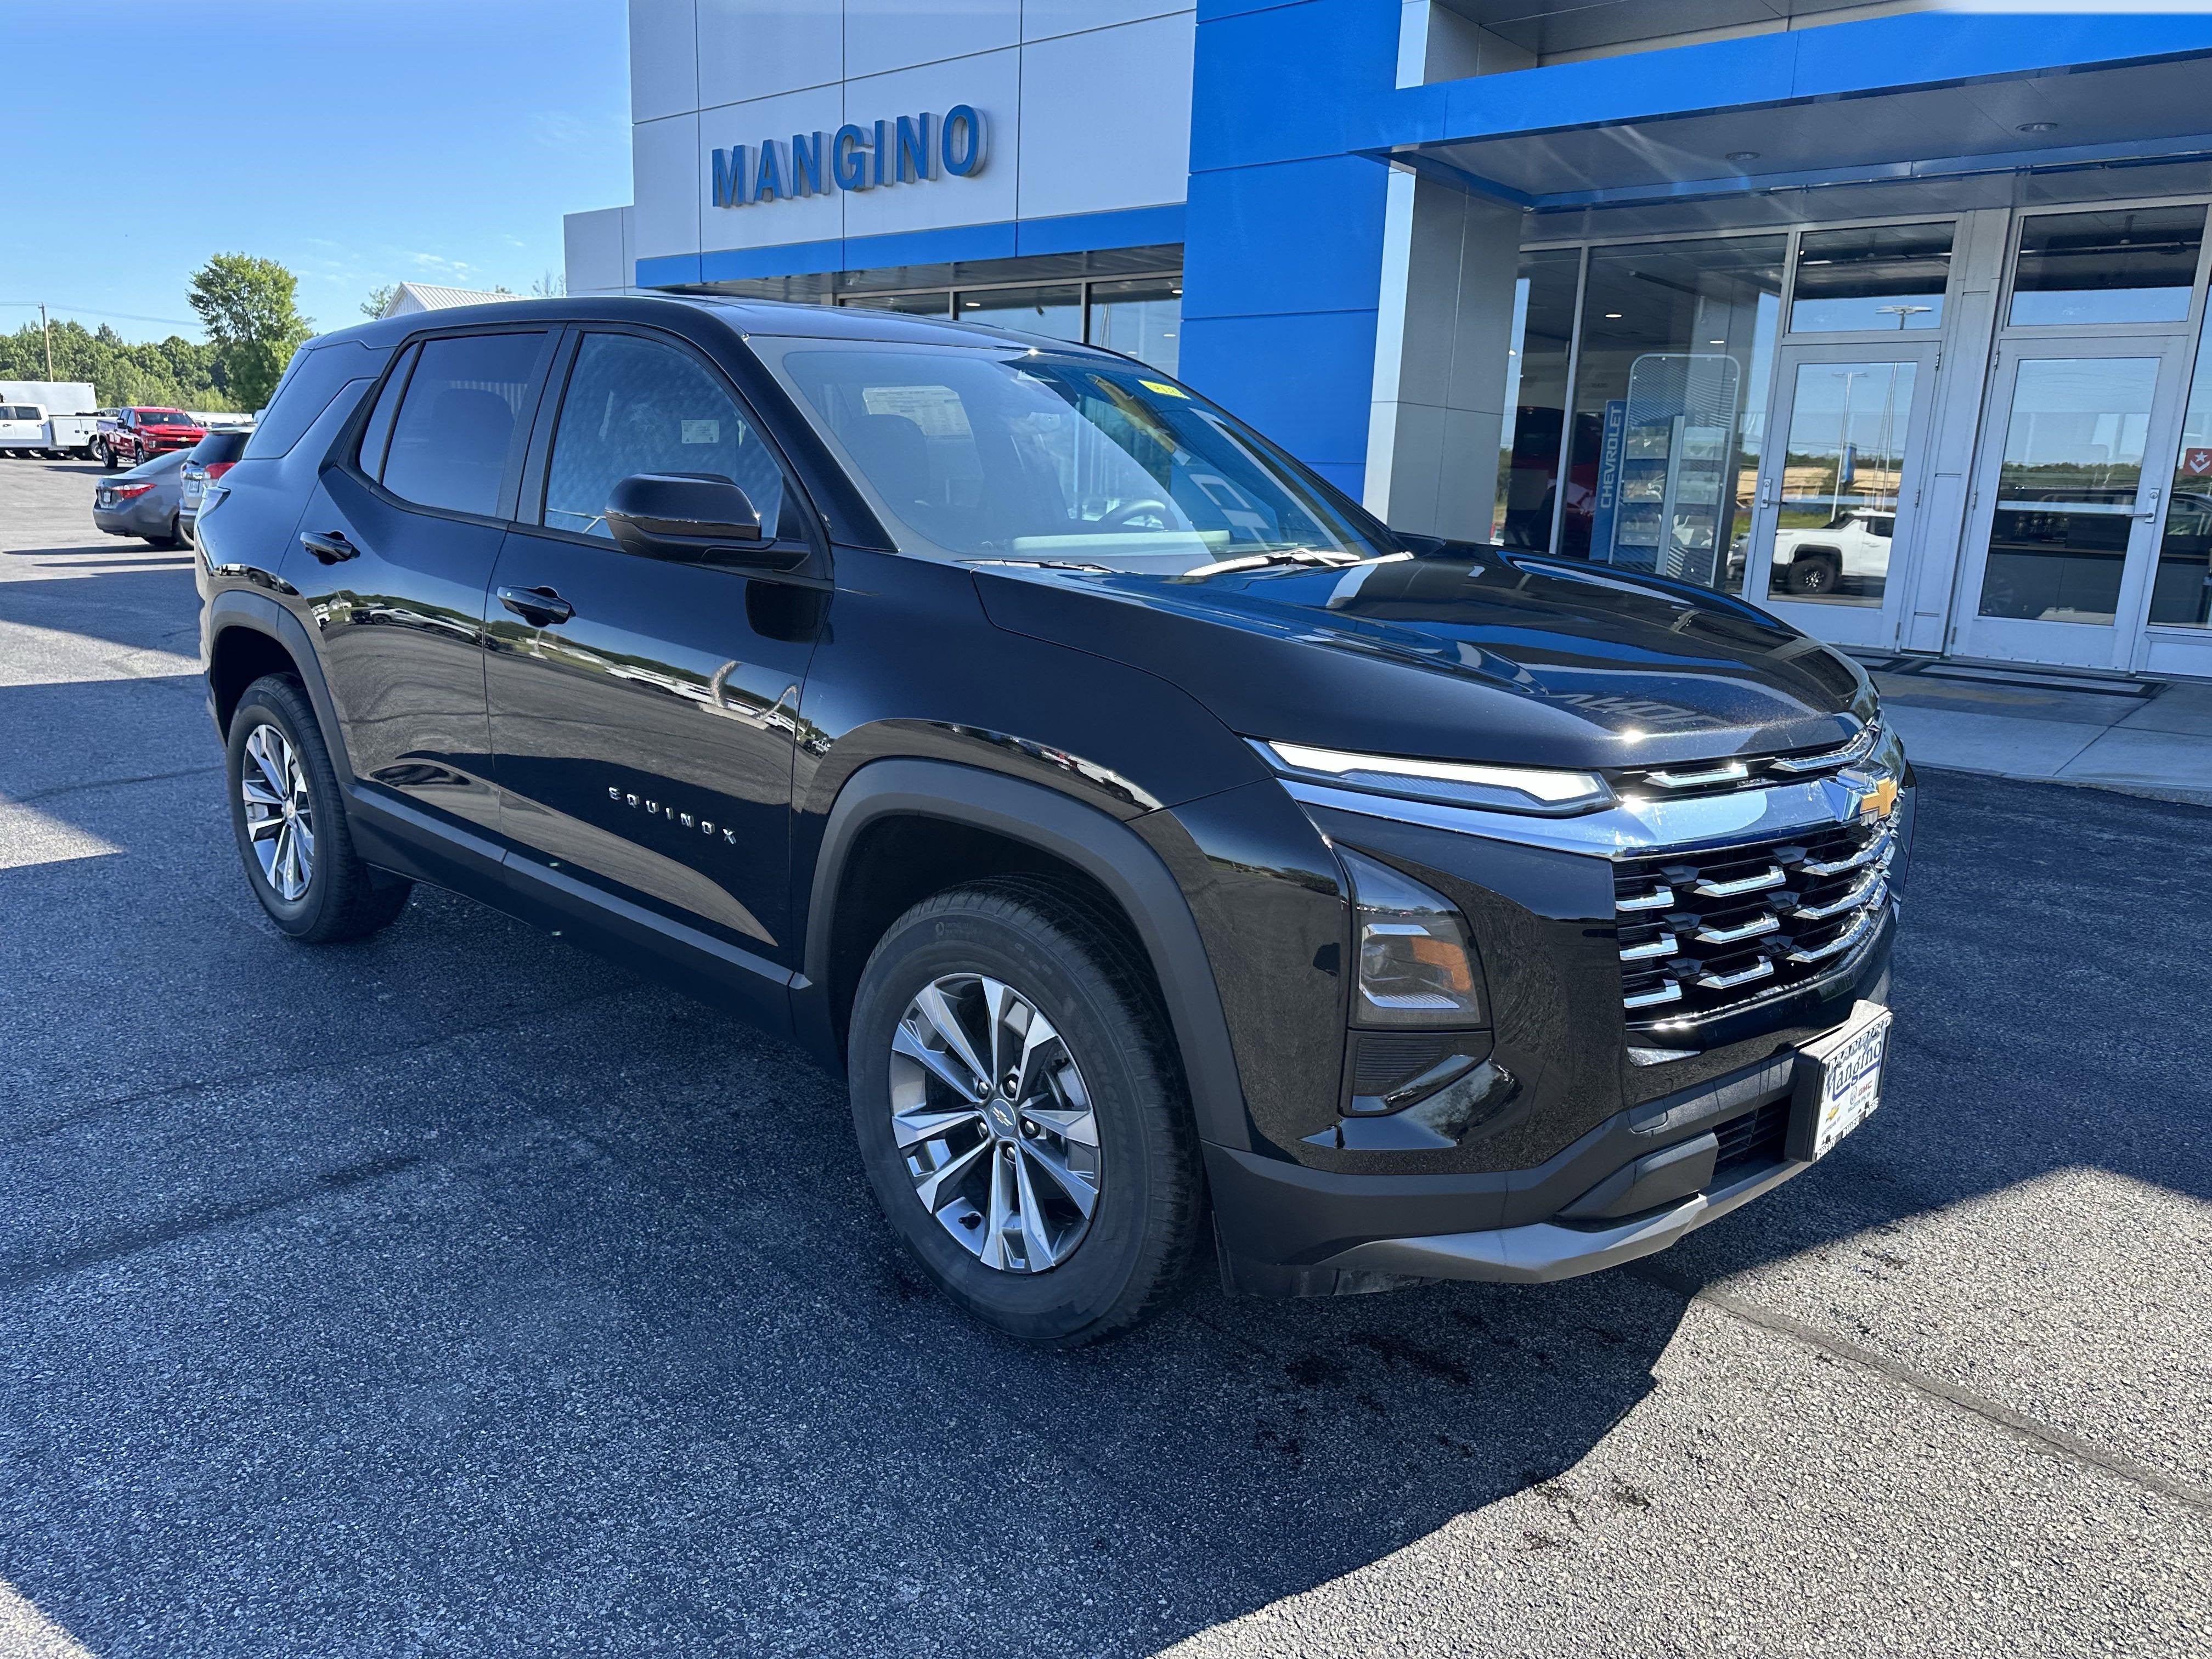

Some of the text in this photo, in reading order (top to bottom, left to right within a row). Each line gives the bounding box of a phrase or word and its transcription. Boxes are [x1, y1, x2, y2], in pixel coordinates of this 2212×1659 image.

[712, 104, 987, 207] MANGINO
[1600, 407, 1622, 508] CHEVROLET
[608, 787, 736, 844] EQUINOX
[1822, 1041, 1882, 1102] Mangino
[1858, 1080, 1872, 1096] GMC
